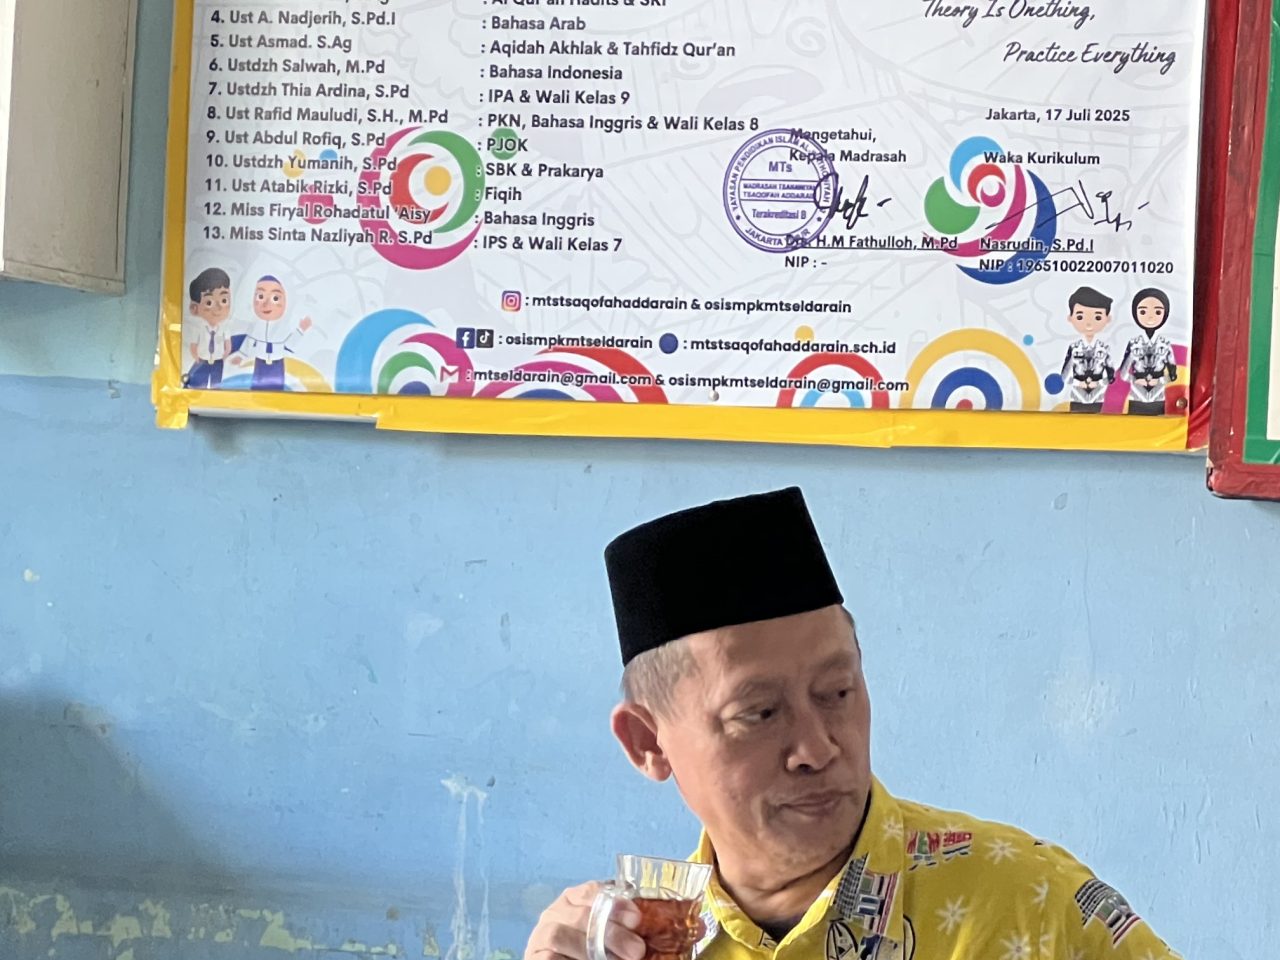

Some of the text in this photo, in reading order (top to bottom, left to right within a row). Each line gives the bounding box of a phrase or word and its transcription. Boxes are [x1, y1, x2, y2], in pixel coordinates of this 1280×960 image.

[211, 11, 225, 24] 4.
[230, 11, 254, 24] Ust
[258, 12, 273, 24] A.
[278, 11, 346, 28] Nadjerih,
[491, 16, 586, 30] Bahasa Arab
[922, 0, 1095, 30] Theory Is Onething,
[210, 35, 352, 52] 5. Ust Asmad. S.Ag
[490, 40, 736, 58] Aqidah Akhlak & Tahfidz Qur'an
[209, 58, 385, 76] 6. Ustdzh Salwah, M.Pd
[1004, 42, 1176, 75] Practice Everything
[490, 65, 623, 80] Bahasa Indonesia
[209, 82, 409, 100] 7. Ustdzh Thia Ardina, S.Pd
[489, 89, 631, 105] IPA & Wali Kelas 9
[207, 106, 448, 126] 8. Ust Rafid Mauludi, S.H., M.Pd
[487, 114, 759, 133] PKN, Bahasa Inggris & Wali Kelas 8
[985, 108, 1130, 122] Jakarta, 17 Juli 2025
[206, 131, 385, 149] 9. Ust Abdul Rofiq, S.Pd
[487, 138, 528, 152] PJOK
[791, 129, 877, 143] Mengetahui,
[206, 155, 396, 173] 10. Ustdzh Yumanih, S.Pd
[768, 161, 793, 172] MTs
[789, 150, 906, 165] Kepala Madrasah
[984, 152, 1100, 164] Waka Kurikulum
[486, 163, 604, 181] SBK & Prakarya
[205, 179, 392, 196] 11. Ust Atabik Rizki, S.Pd
[485, 186, 522, 204] Fiqih
[204, 202, 226, 215] 12.
[231, 202, 265, 216] Miss
[269, 203, 308, 221] Firyal
[313, 205, 389, 220] Rohadatul
[484, 211, 595, 230] Bahasa Inggris
[203, 226, 432, 246] 13. Miss Sinta Nazliyah R. S.Pd
[483, 236, 622, 251] IPS & Wali Kelas 7
[745, 226, 783, 246] JAKARTA
[816, 236, 844, 248] H.M
[849, 236, 917, 250] Fathulloh,
[921, 236, 957, 248] M.Pd
[981, 238, 1048, 252] Nasrudin,
[785, 257, 809, 267] NIP
[979, 259, 1173, 273] NIP 196510022007011020
[532, 295, 852, 315] mtstsaqofahaddarain & osismpkmtseldarain
[505, 334, 896, 354] osismpkmtseldarain mtstsaqofahaddarain.sch.id
[473, 369, 909, 394] mtseldarain@gmail.com & osismpkmtseldarain@gmail.com
